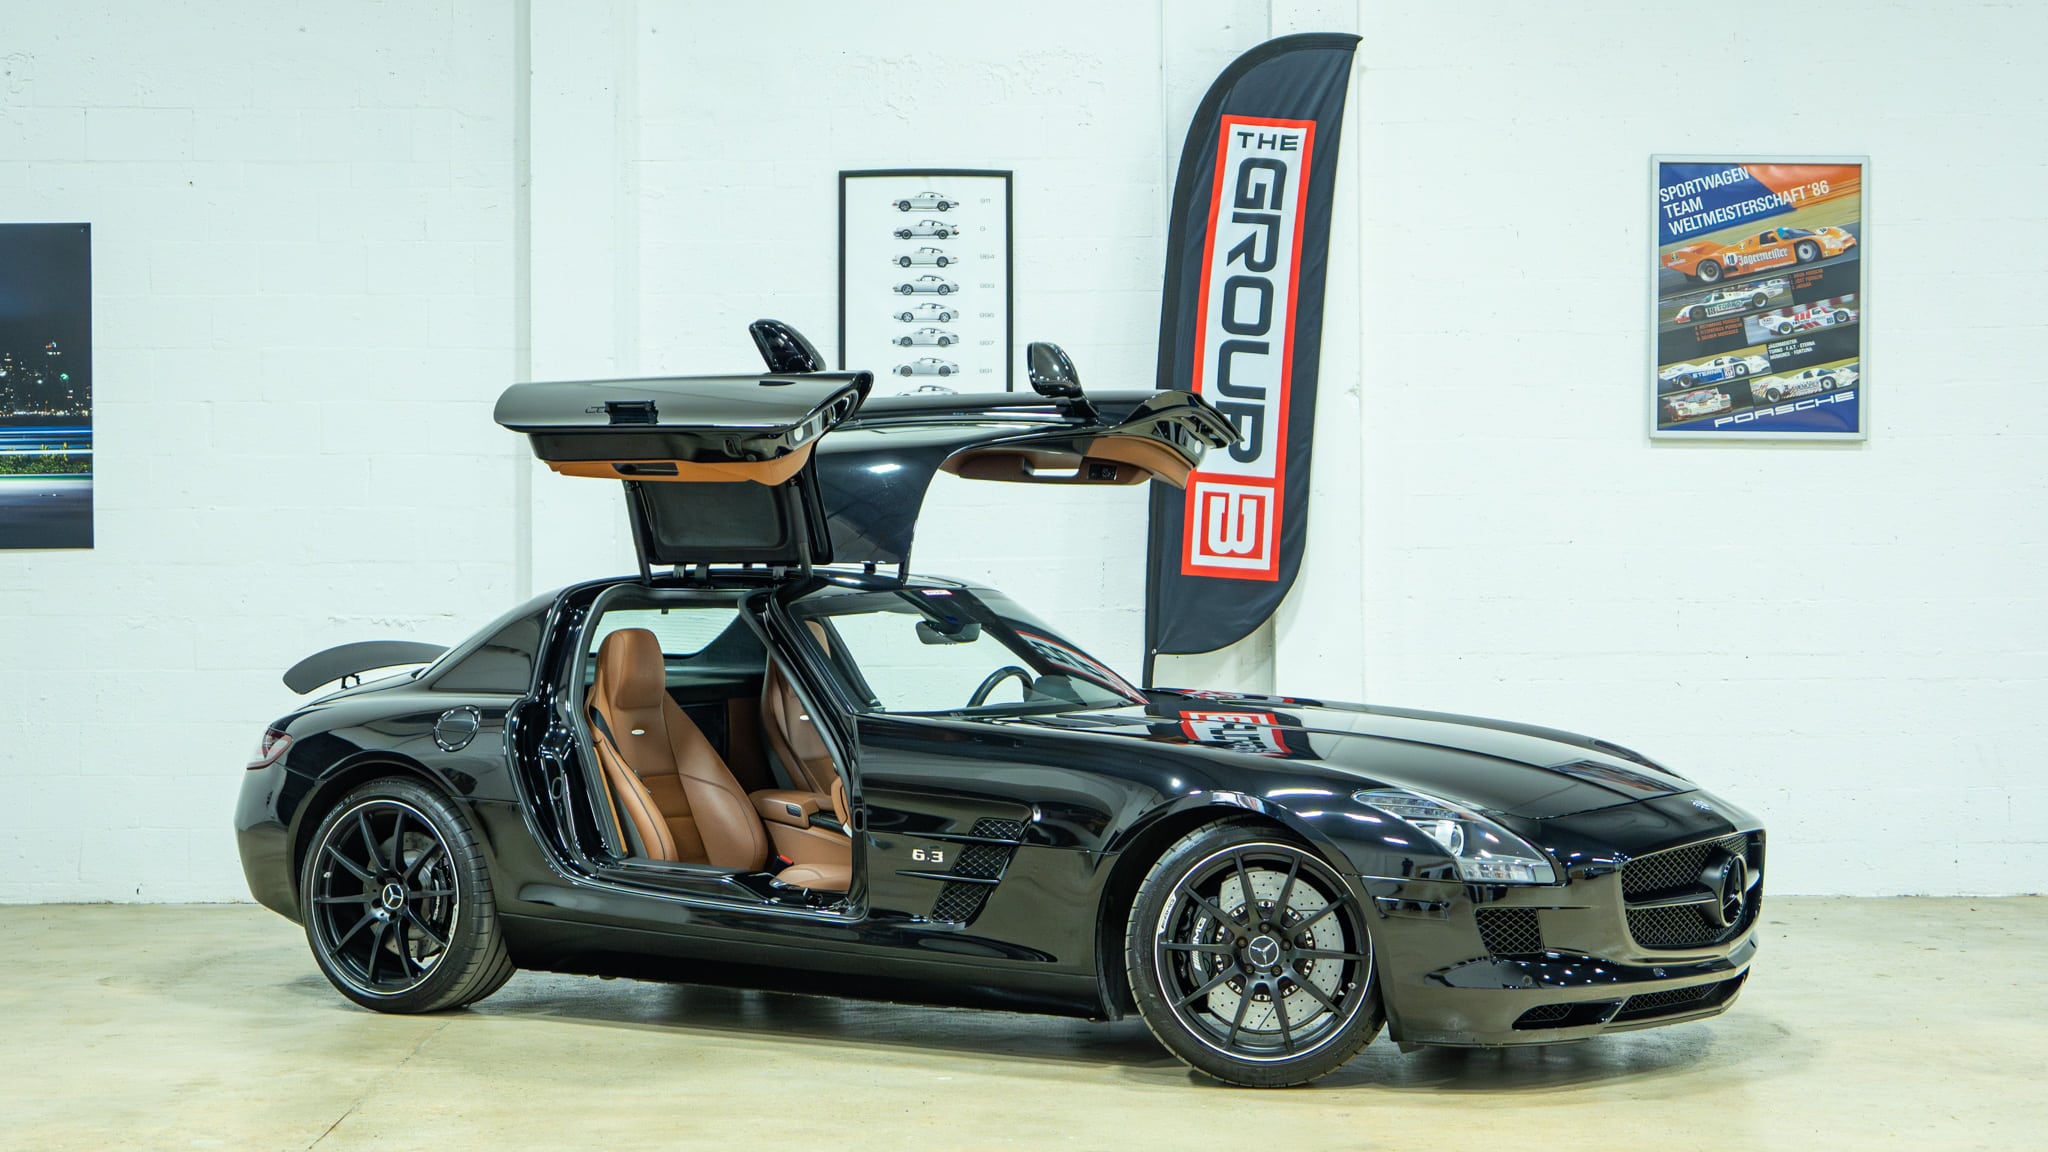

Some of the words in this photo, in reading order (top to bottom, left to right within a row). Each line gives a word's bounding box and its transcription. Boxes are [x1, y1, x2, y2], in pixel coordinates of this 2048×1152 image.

[1236, 131, 1299, 151] THE
[1659, 166, 1750, 202] SPORTWAGEN
[1663, 197, 1704, 219] TEAM
[1668, 185, 1805, 236] WELTMEISTERSCHAFT
[1216, 157, 1287, 464] GROUP
[1713, 391, 1855, 428] PORSCHE
[1208, 495, 1257, 554] 3
[912, 848, 943, 863] 6.3
